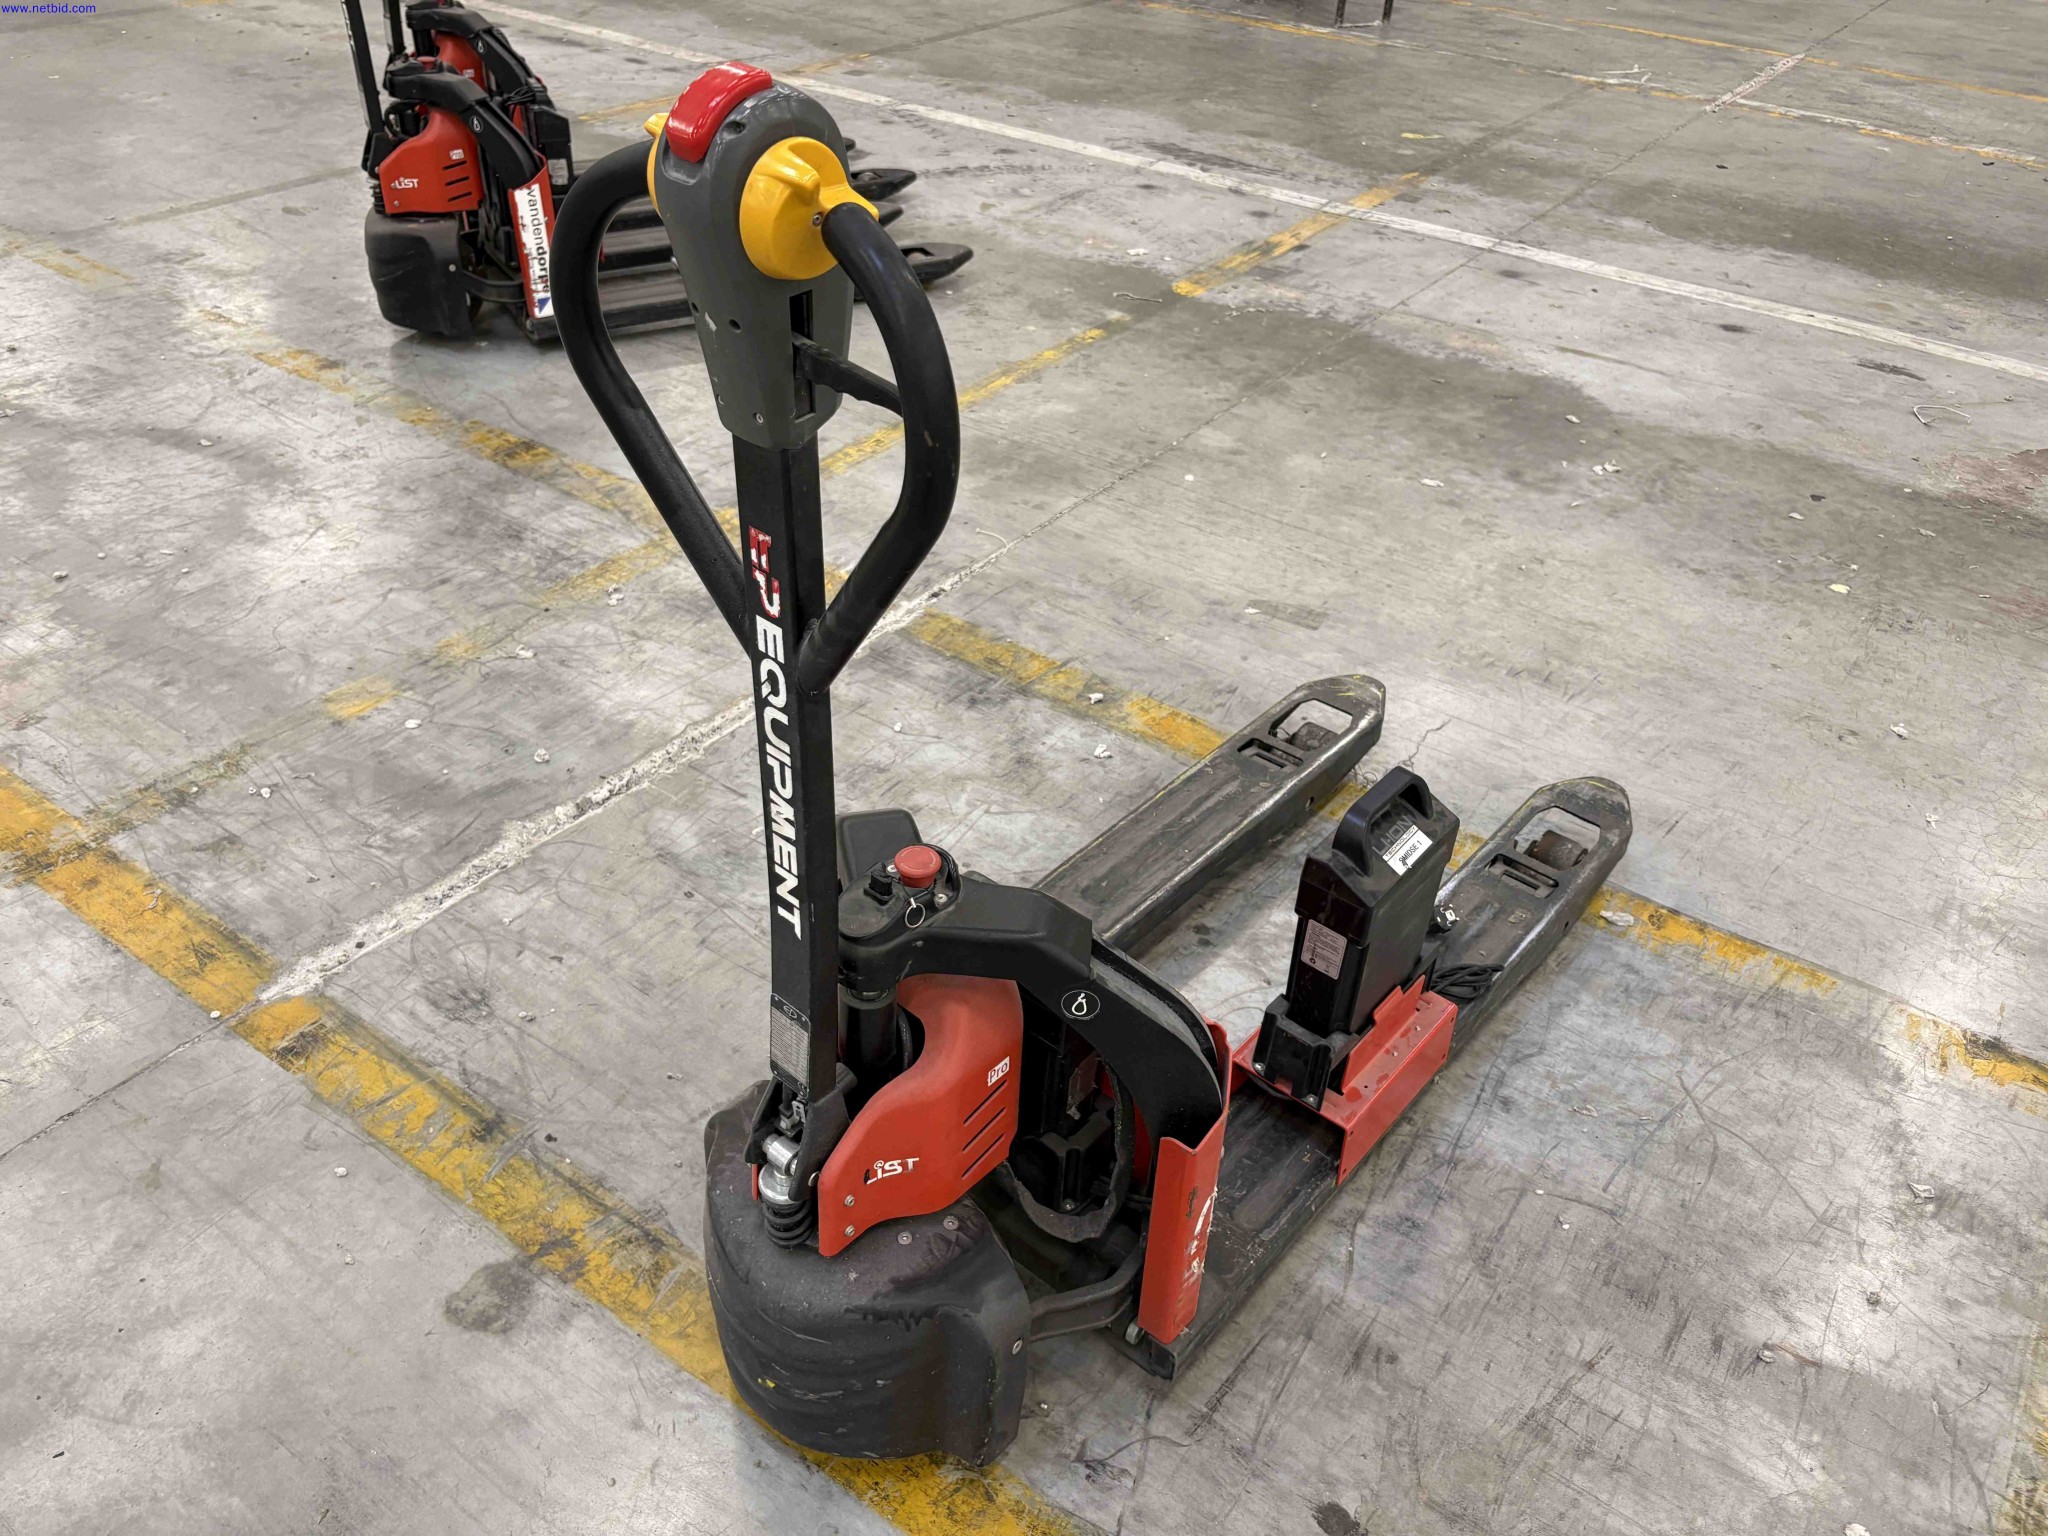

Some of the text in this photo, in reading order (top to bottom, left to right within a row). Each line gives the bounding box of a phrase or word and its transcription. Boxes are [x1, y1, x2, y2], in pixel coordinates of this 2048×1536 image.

[756, 615, 802, 941] EQUIPMENT
[1384, 826, 1416, 858] TECHNOLOGY
[988, 1059, 1010, 1084] Pro
